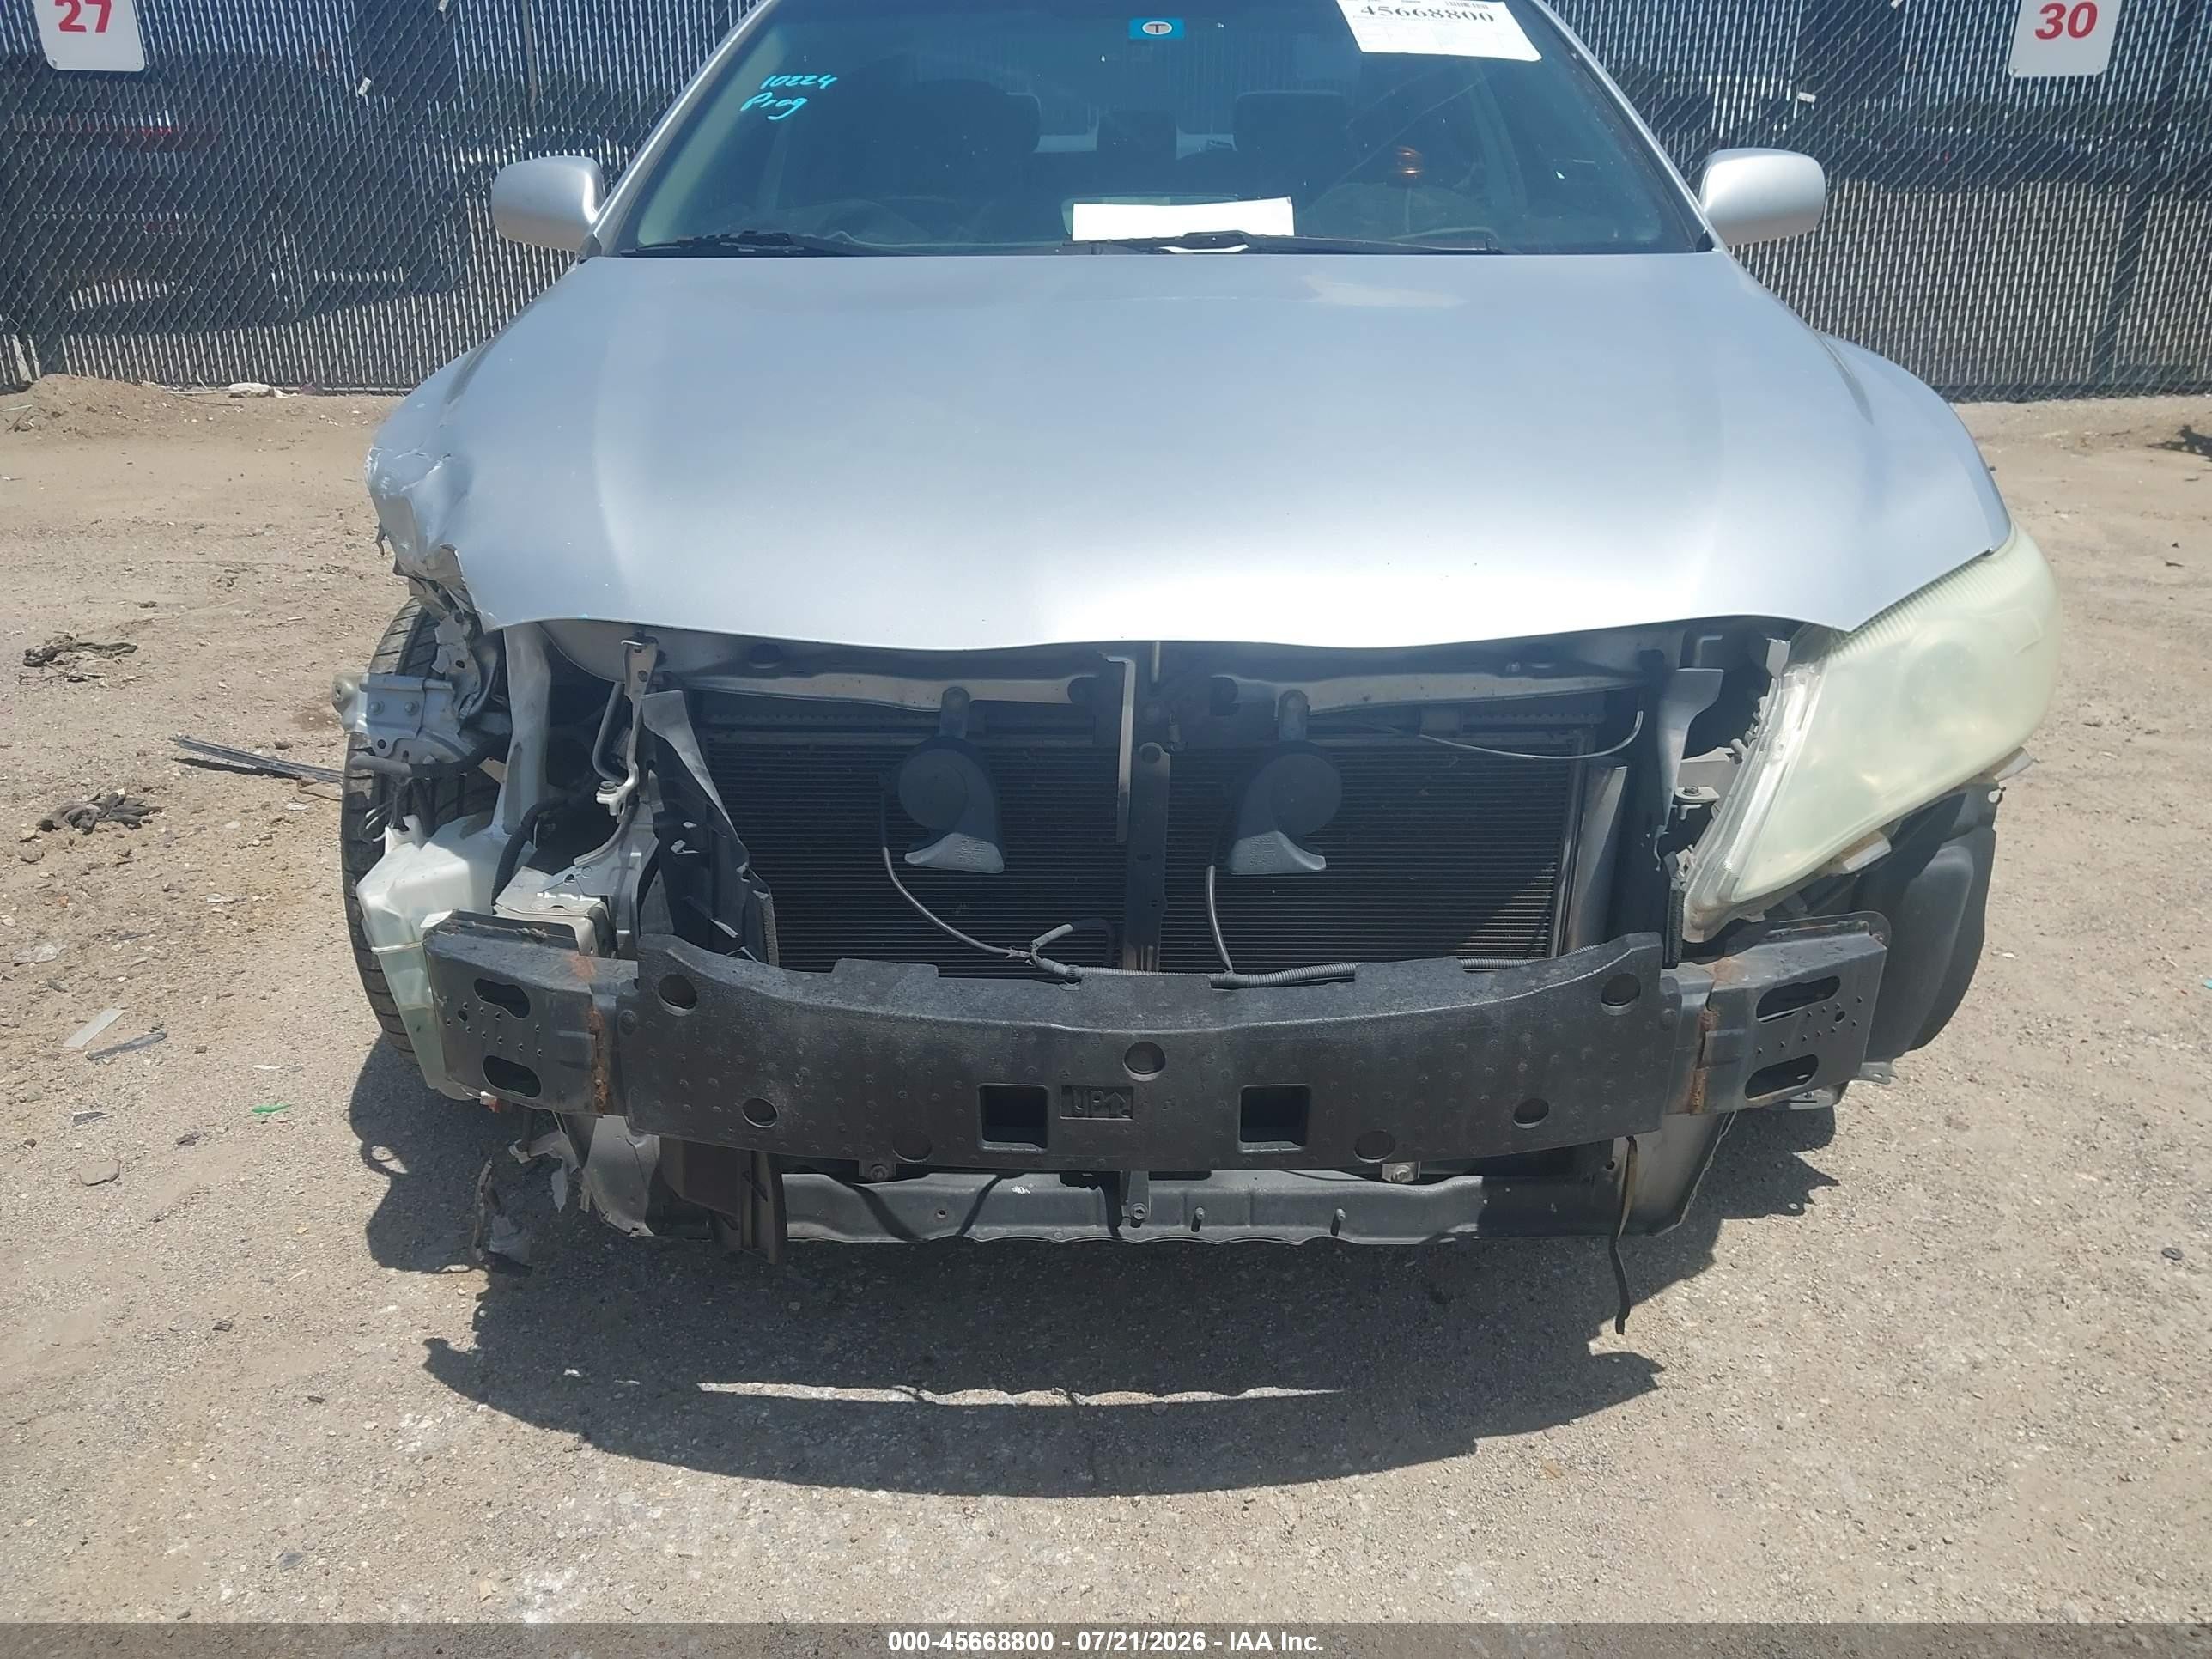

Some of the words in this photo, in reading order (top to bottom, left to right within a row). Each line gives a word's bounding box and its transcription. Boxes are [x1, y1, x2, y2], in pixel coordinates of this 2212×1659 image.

[55, 0, 112, 33] 27
[1361, 5, 1495, 22] 45668800
[2035, 2, 2098, 40] 30
[759, 74, 838, 89] 10224
